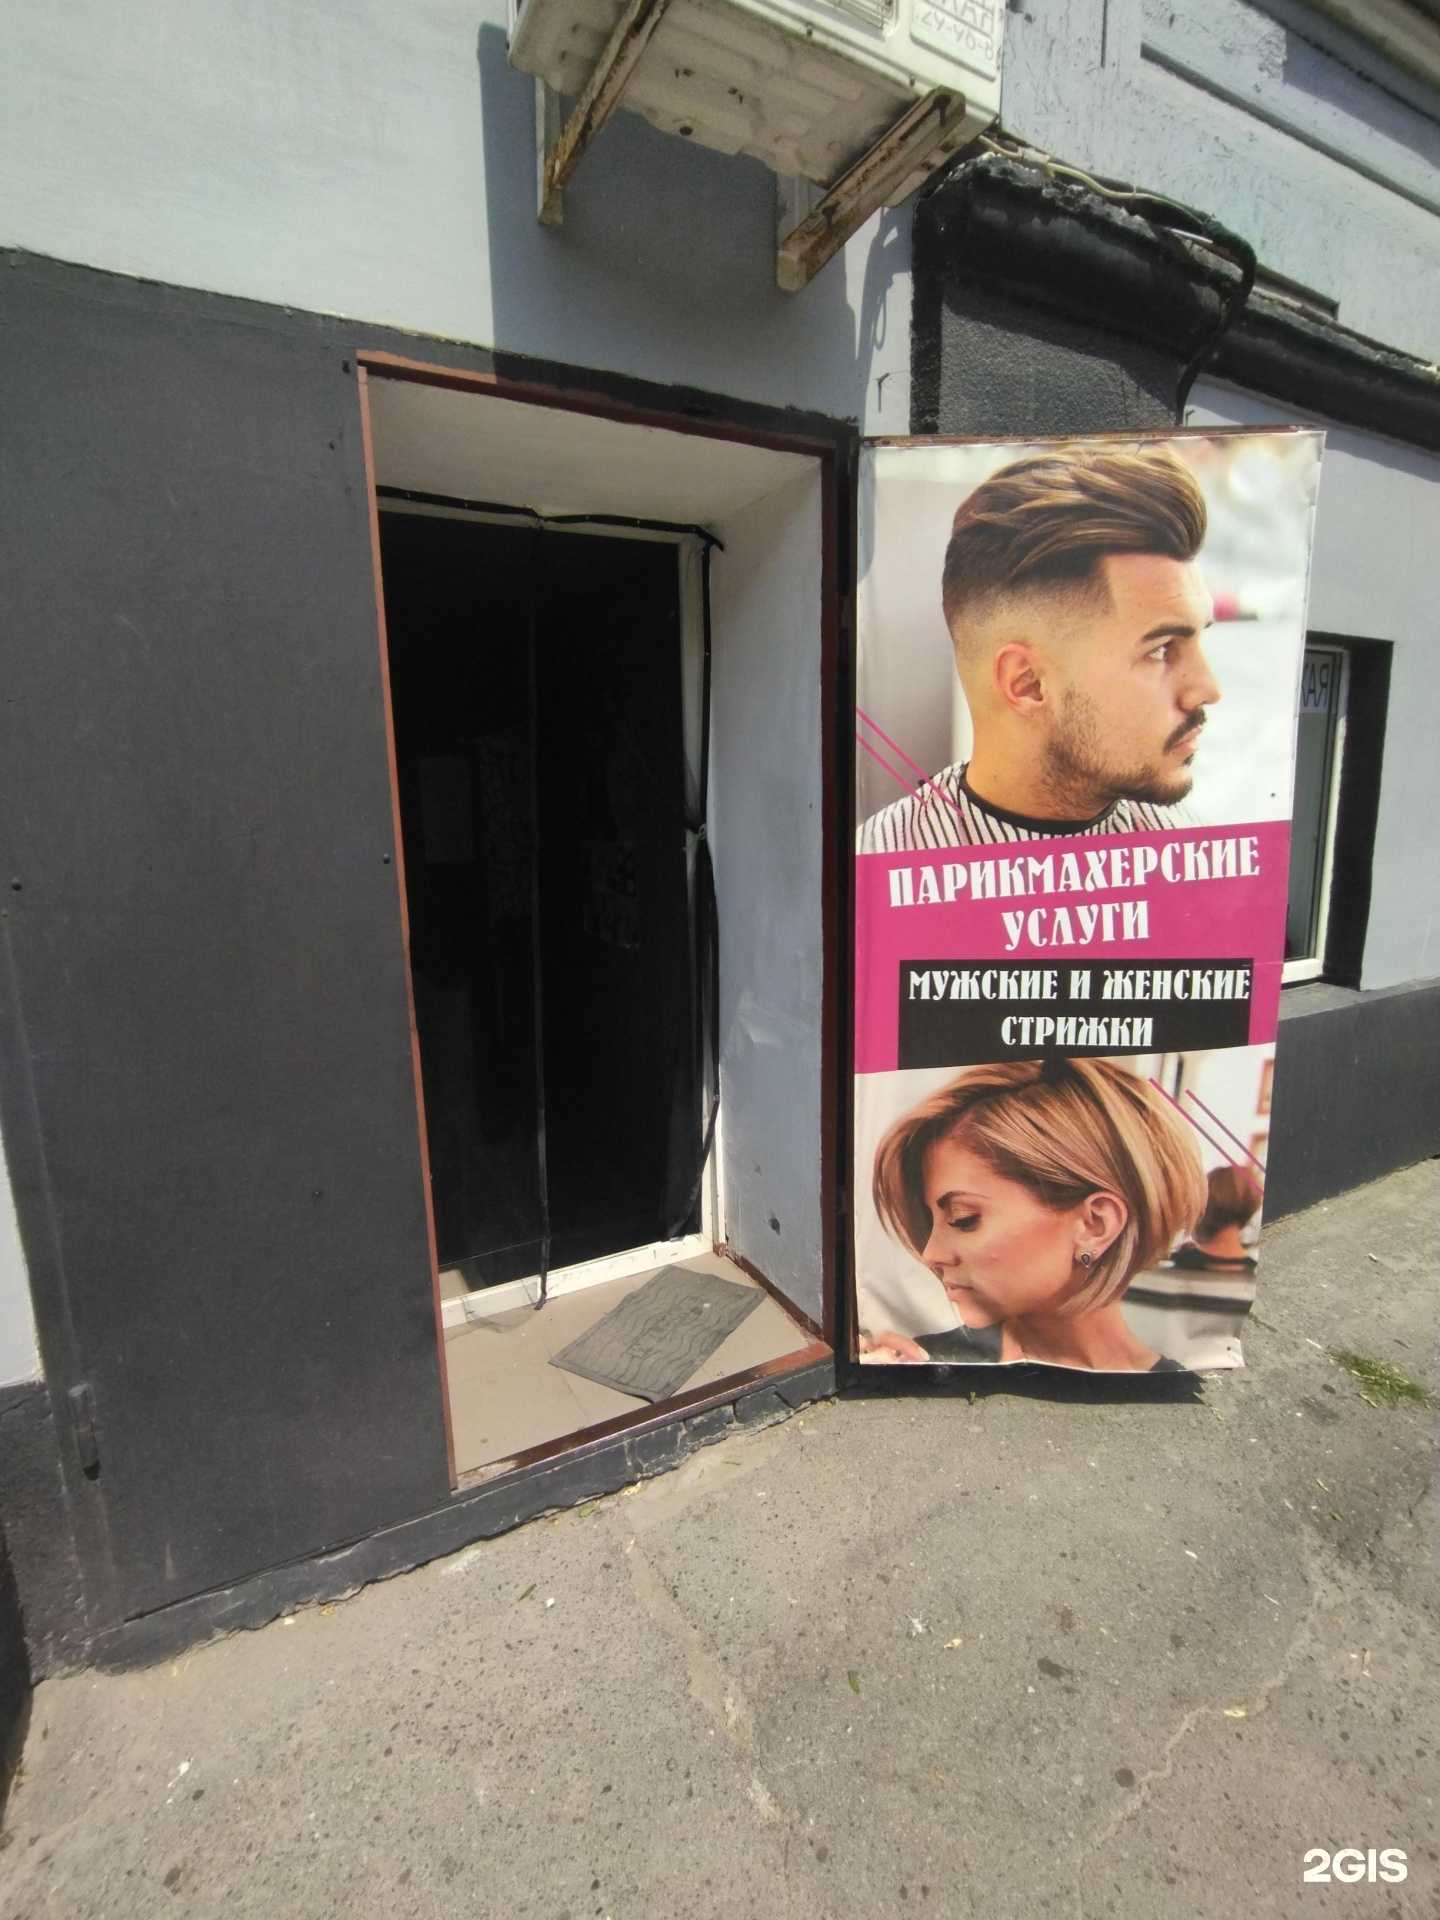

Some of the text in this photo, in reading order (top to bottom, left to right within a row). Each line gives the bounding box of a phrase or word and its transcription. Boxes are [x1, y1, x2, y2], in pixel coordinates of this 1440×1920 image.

[888, 837, 1260, 907] ПАРИКМАХЕРСКИЕ
[1002, 901, 1149, 950] УСЛУГИ
[909, 970, 1250, 1000] МУЖСКИЕ И ЖЕНСКИЕ
[1001, 1016, 1153, 1046] СТРИЖКИ
